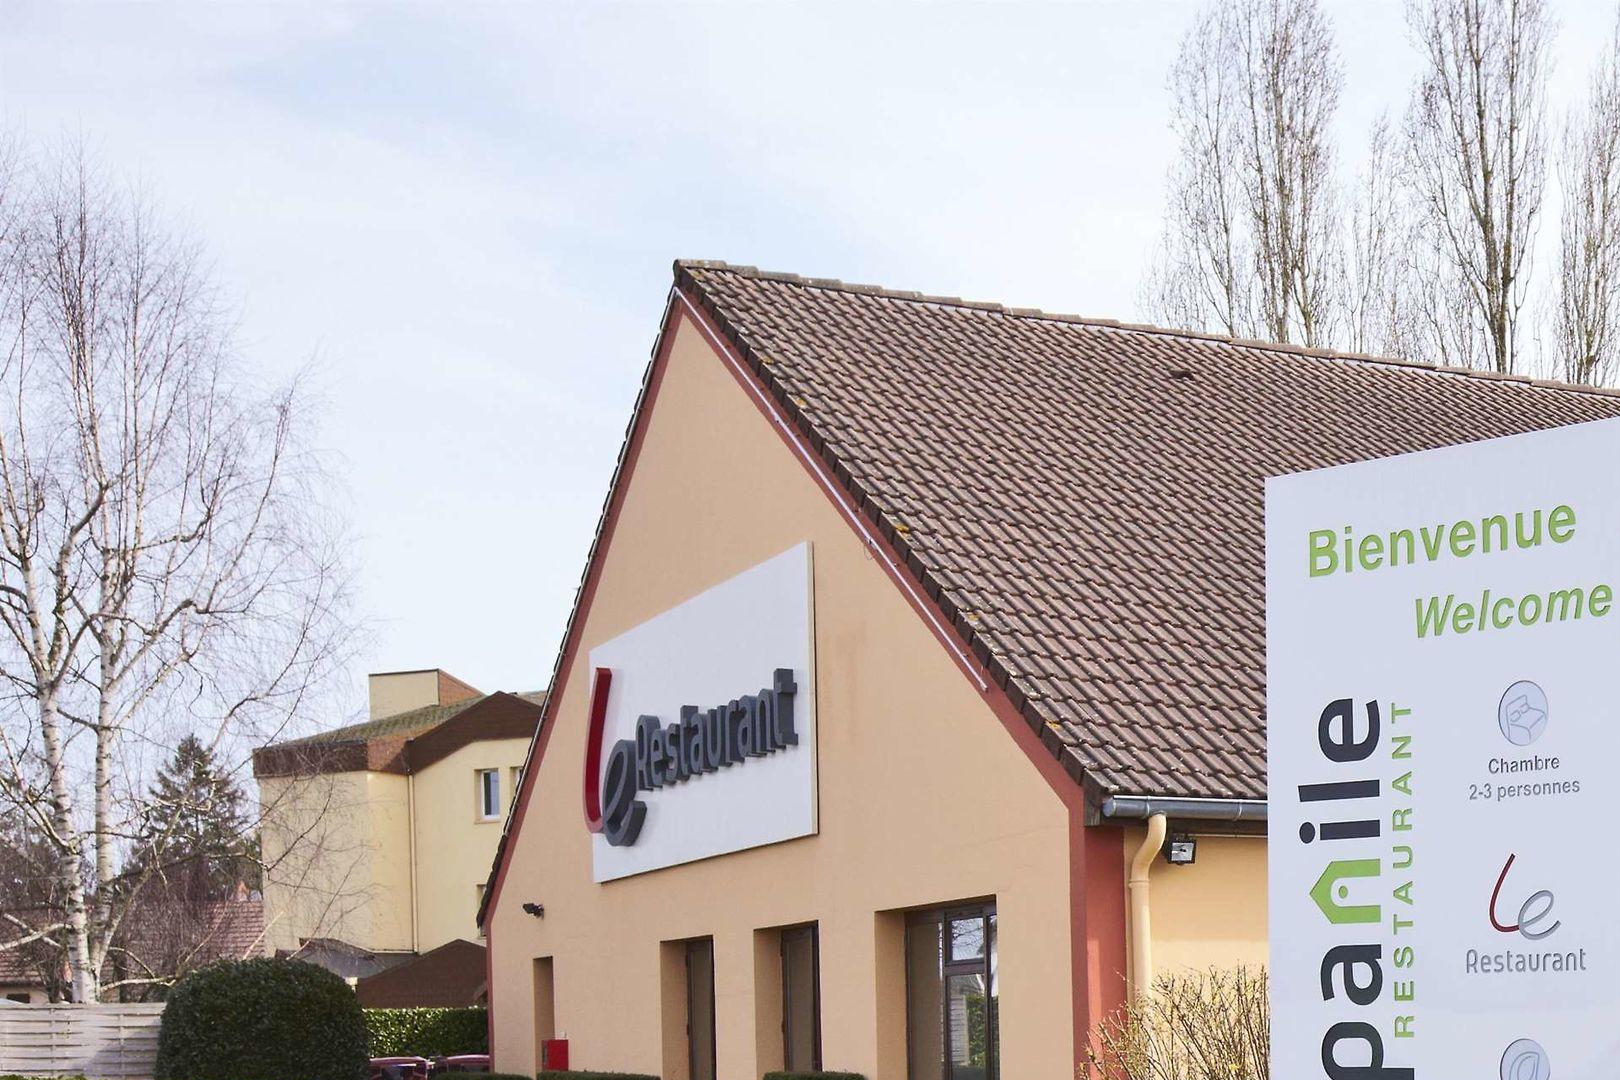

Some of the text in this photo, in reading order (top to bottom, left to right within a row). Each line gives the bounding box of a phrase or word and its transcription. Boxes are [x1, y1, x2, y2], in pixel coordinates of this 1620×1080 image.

[1308, 503, 1578, 578] Bienvenue
[1414, 581, 1614, 639] Welcome
[635, 668, 799, 792] Restaurant
[1469, 779, 1581, 802] 2-3 personnes
[1488, 755, 1560, 775] Chambre
[1391, 702, 1416, 1039] RESTAURANT
[1465, 948, 1587, 974] Restaurant
